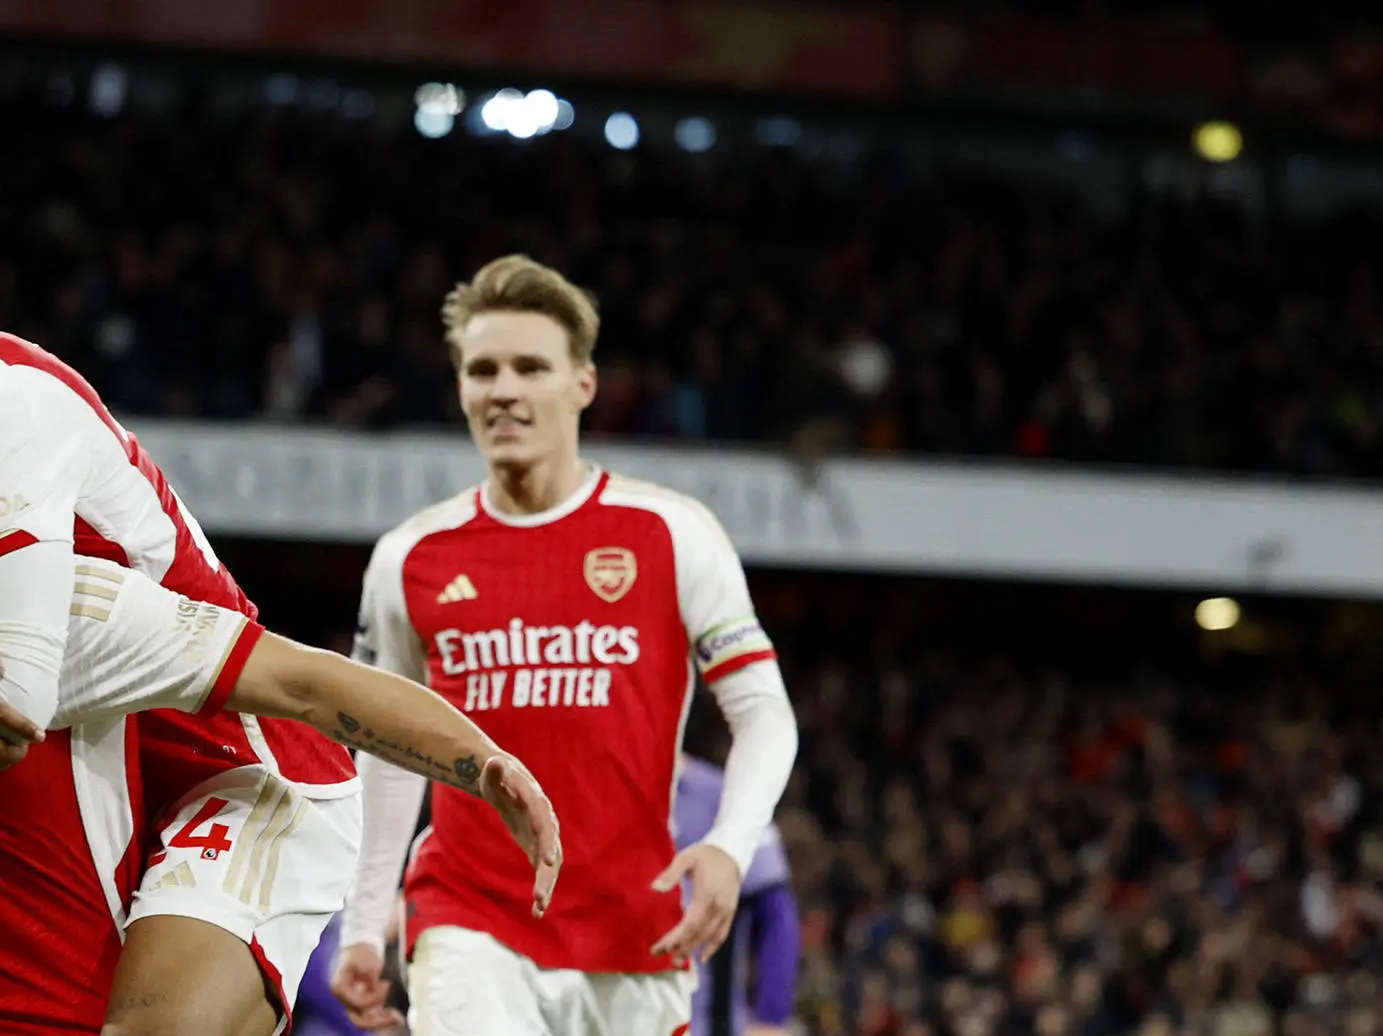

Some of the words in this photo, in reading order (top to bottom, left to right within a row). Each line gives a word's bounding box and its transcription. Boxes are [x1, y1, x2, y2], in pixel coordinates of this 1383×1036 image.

[434, 617, 640, 676] Emirates
[464, 671, 507, 712] FLY
[512, 667, 612, 707] BETTER
[167, 796, 233, 861] 4
